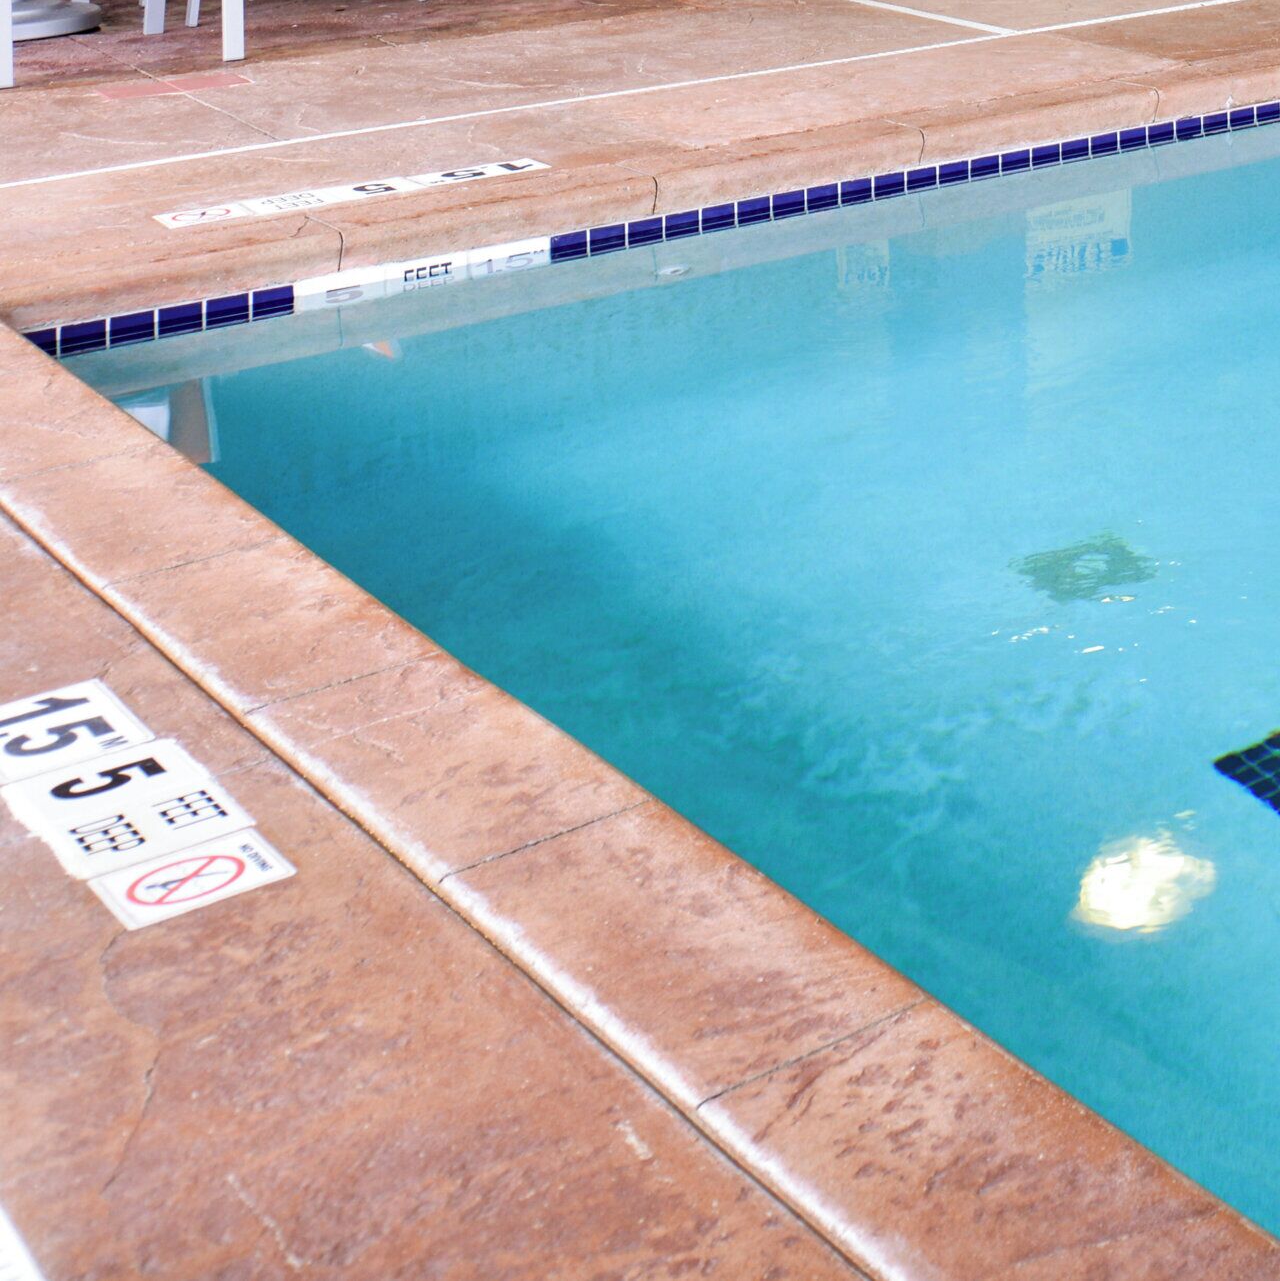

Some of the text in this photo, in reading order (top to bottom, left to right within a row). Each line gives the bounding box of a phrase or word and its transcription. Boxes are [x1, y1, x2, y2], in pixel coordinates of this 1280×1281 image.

[352, 183, 397, 195] 5
[50, 757, 168, 801] 5
[151, 789, 229, 831] FEET
[69, 813, 147, 856] DEEP
